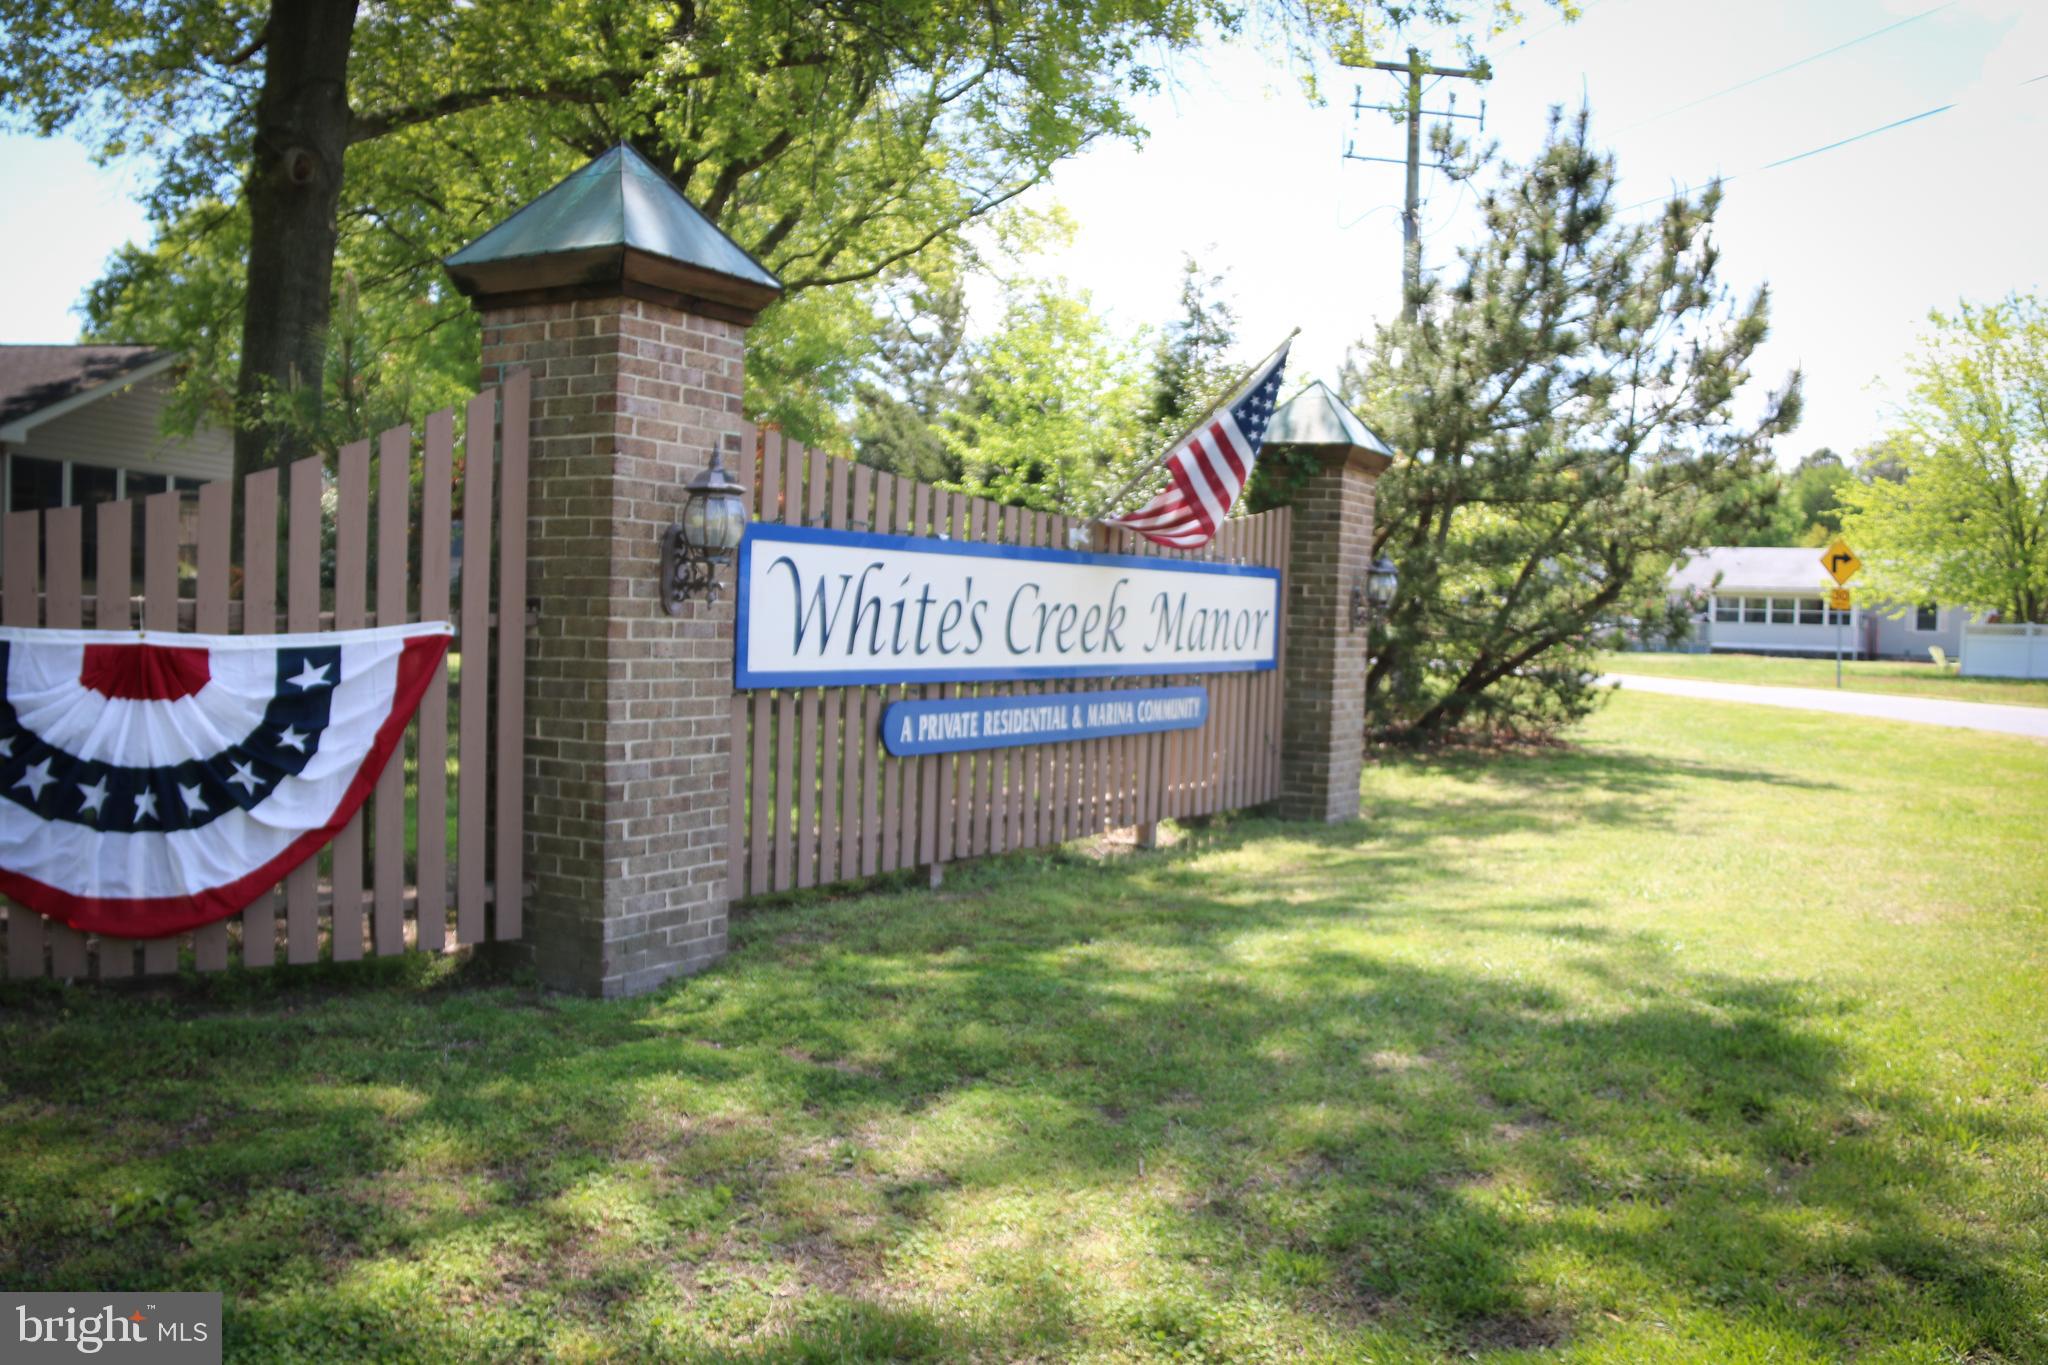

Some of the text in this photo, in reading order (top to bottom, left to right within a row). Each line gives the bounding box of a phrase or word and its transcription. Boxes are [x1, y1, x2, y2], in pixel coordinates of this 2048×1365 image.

[766, 555, 1269, 657] White's Creek Manor
[900, 697, 1201, 743] A PRIVATE RESIDENTIAL & MARINA COMMUNITY
